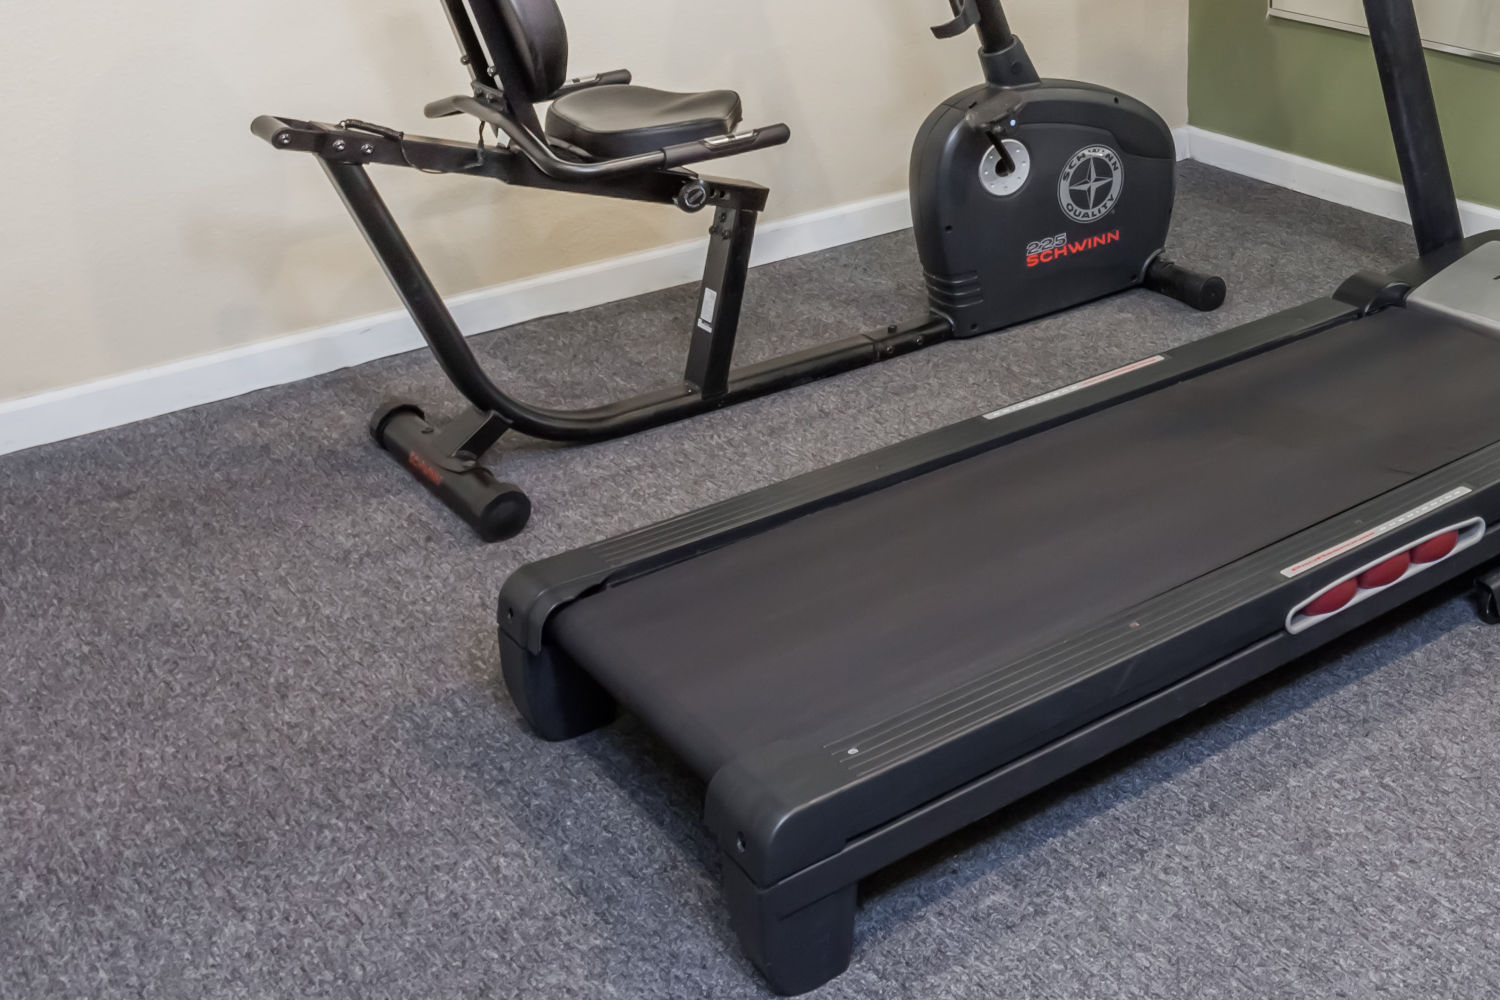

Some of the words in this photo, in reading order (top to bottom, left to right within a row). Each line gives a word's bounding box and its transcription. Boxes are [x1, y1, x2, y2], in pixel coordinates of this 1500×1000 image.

[1066, 193, 1115, 219] QUALITY
[1026, 232, 1067, 256] 225
[1026, 230, 1120, 267] SCHWINN
